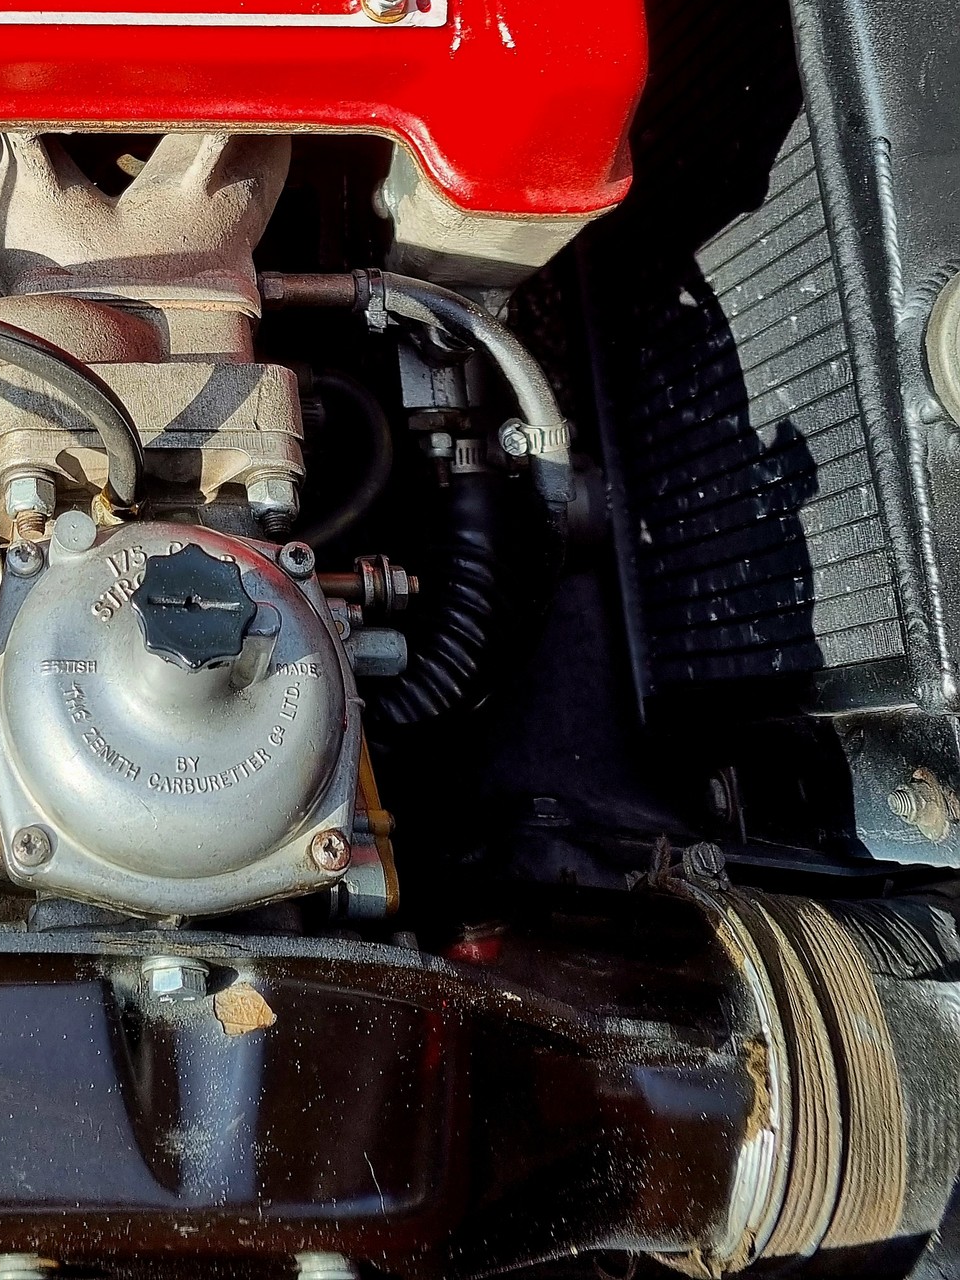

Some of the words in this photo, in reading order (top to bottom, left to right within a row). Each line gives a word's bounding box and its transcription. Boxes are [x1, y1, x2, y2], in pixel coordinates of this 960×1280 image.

[105, 545, 147, 578] 175
[275, 662, 320, 678] MADE
[82, 726, 141, 782] ZENITH
[147, 747, 271, 795] CARBURETTER
[175, 755, 200, 773] BY
